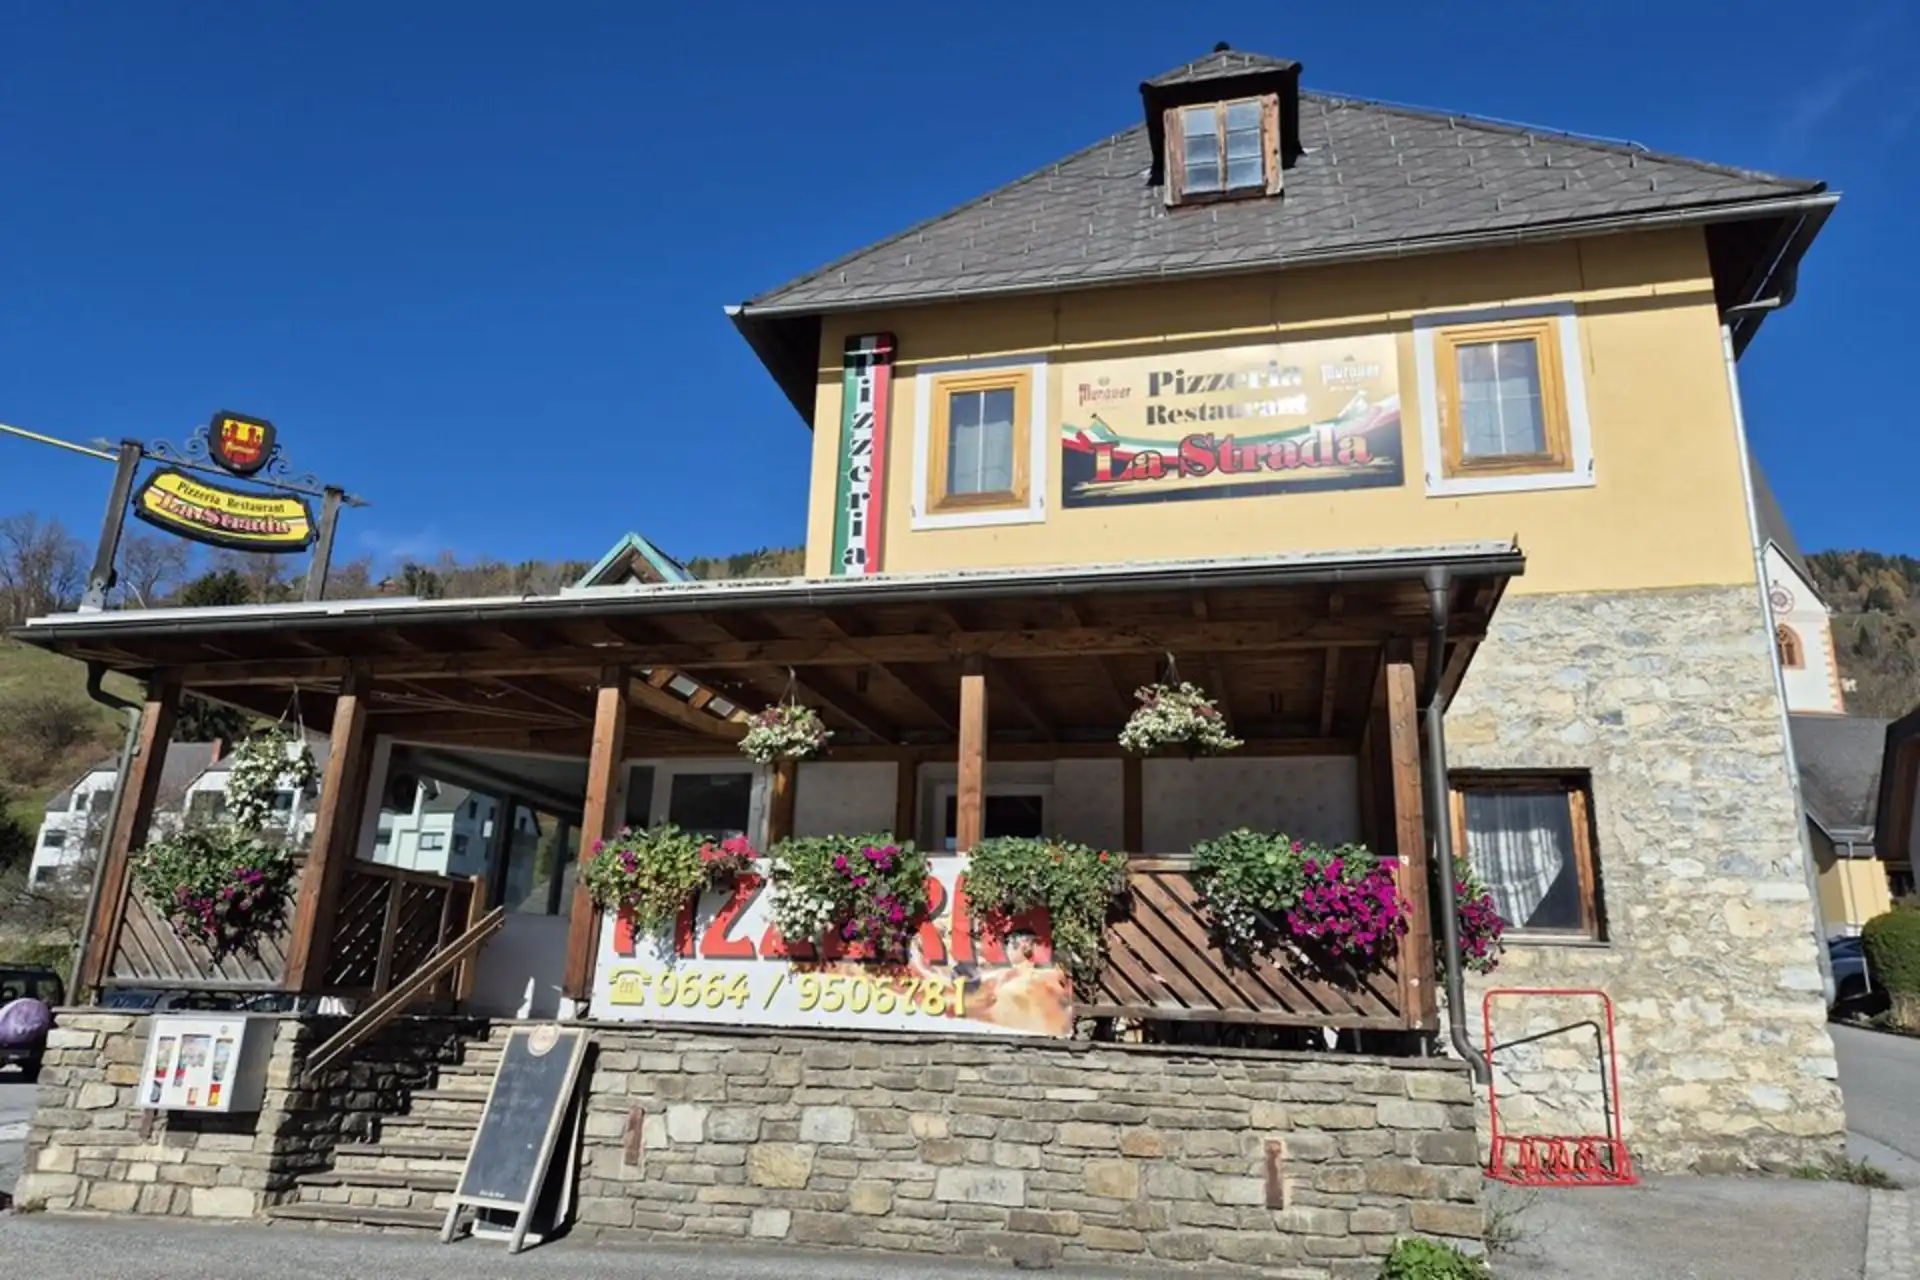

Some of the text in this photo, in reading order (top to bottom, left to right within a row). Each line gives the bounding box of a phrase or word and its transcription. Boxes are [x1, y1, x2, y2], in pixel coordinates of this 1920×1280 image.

[1148, 359, 1304, 398] Pizzeria
[1146, 394, 1309, 426] Restaurant
[843, 353, 885, 566] Pizzeria
[176, 481, 286, 514] Pizzeria Restaurant
[656, 969, 750, 1008] 0664
[798, 973, 967, 1018] 9506781
